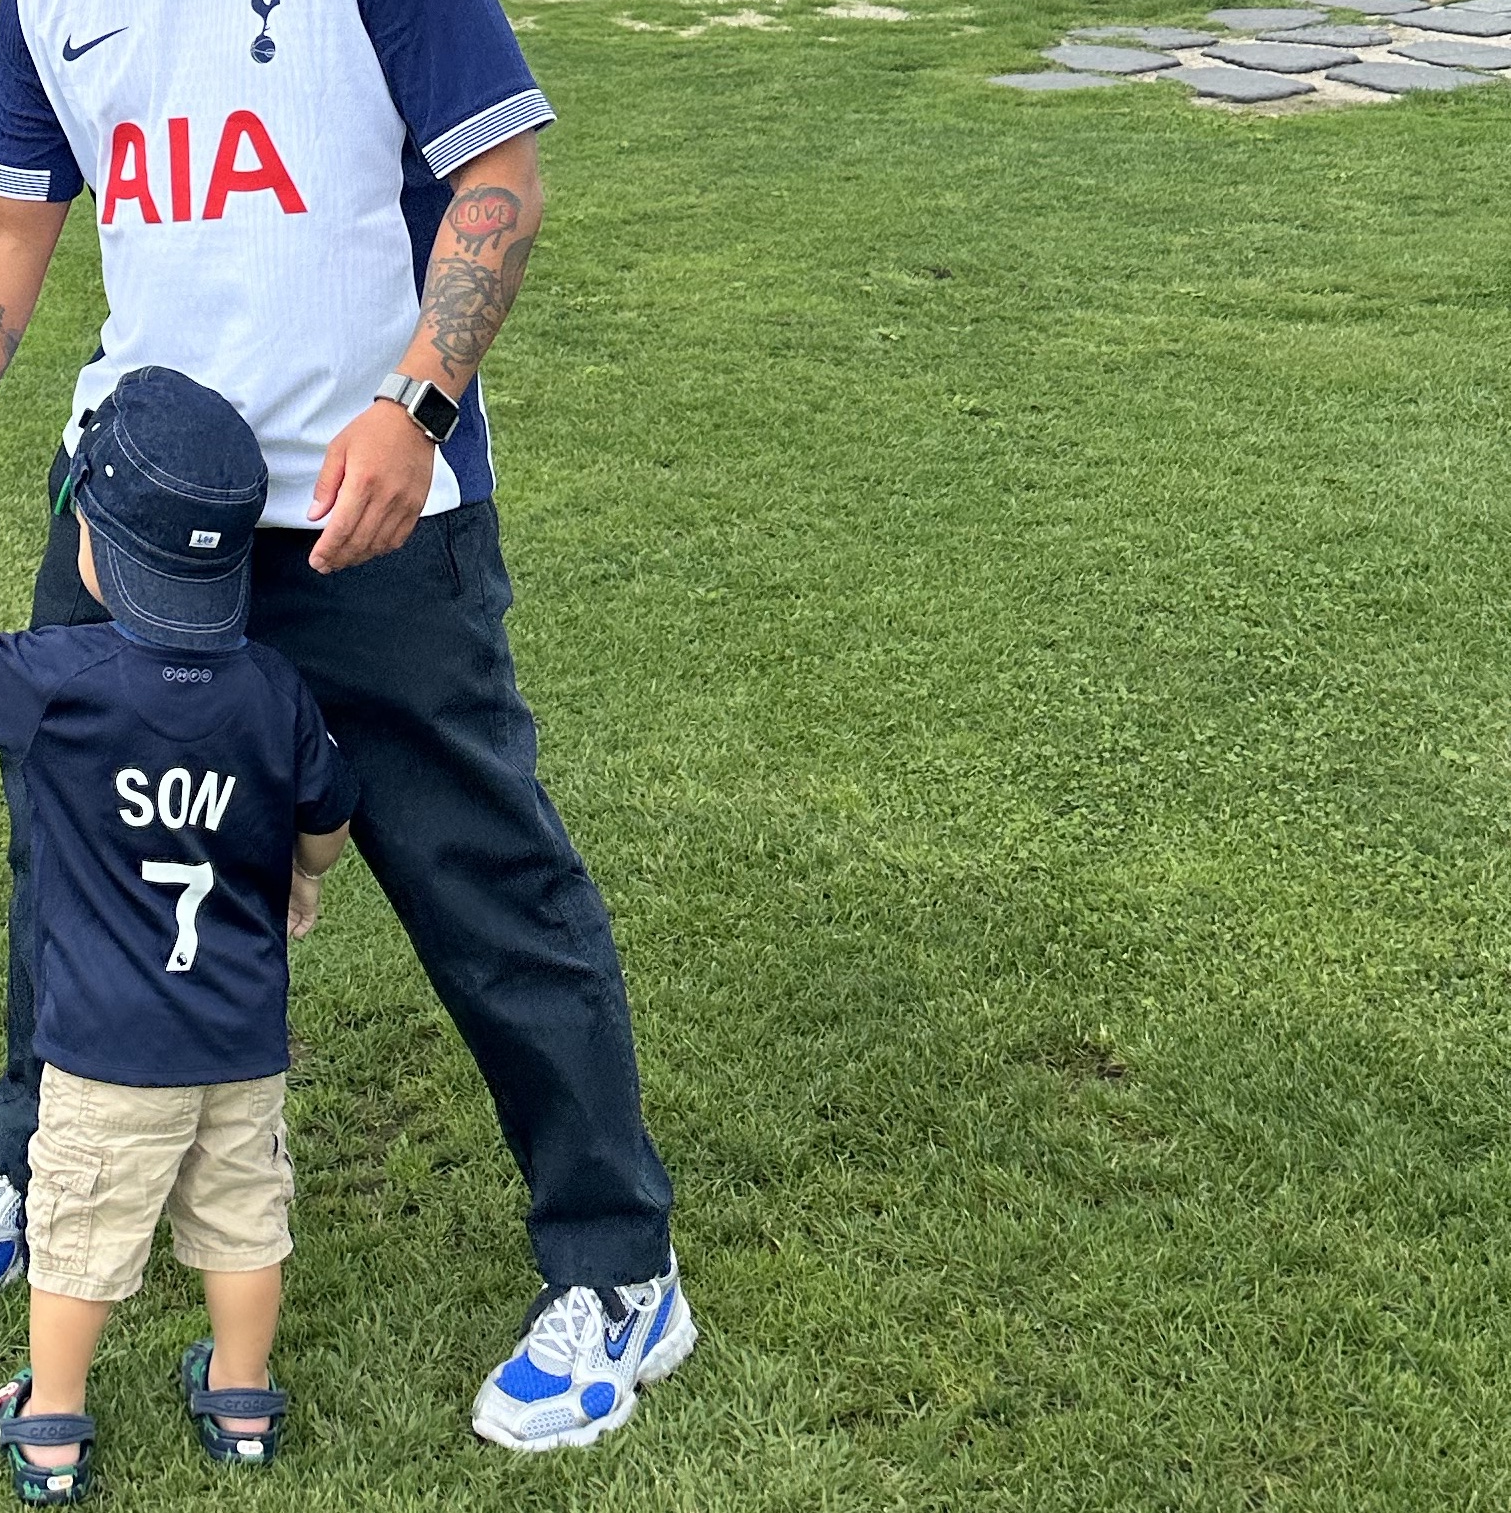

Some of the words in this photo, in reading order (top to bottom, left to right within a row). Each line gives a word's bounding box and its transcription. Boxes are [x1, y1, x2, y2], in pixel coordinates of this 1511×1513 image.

[101, 110, 308, 224] AIA
[454, 204, 508, 224] LOVE
[115, 768, 237, 831] SON
[141, 860, 215, 972] 7
